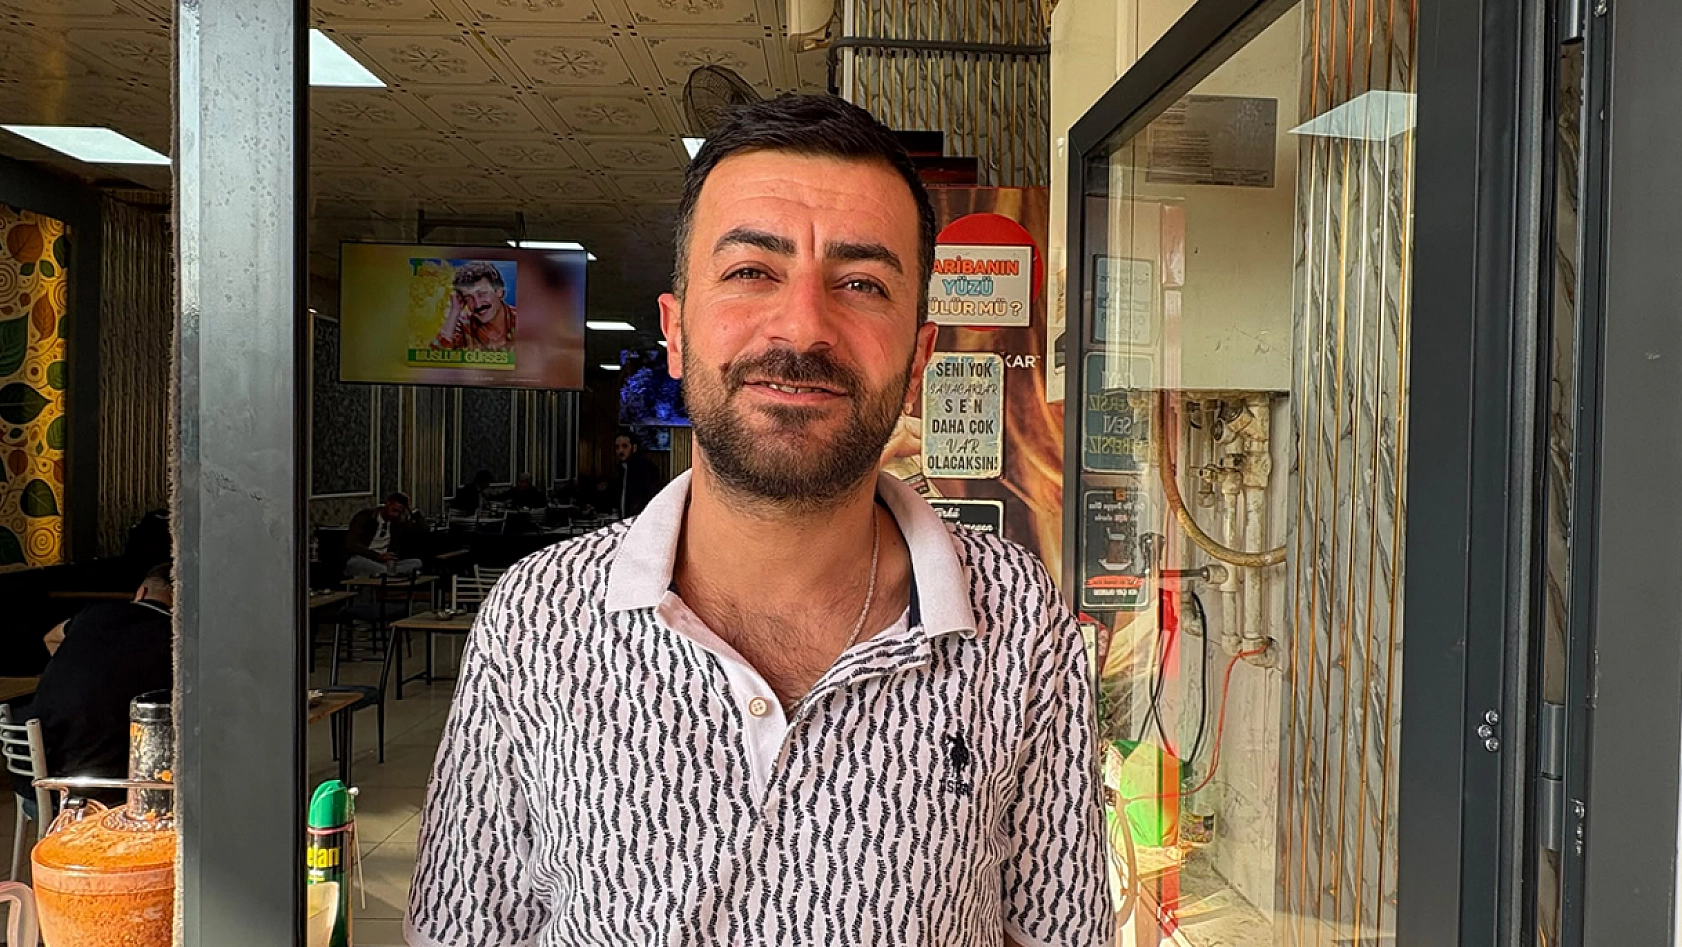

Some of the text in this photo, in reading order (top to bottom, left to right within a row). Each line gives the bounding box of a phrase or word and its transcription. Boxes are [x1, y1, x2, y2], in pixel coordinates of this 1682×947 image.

[932, 255, 1019, 276] ARİBANIN
[942, 276, 993, 296] YÜZÜ
[929, 297, 976, 316] ÜLÜR
[979, 298, 1007, 316] MÜ
[968, 362, 993, 378] YOK
[929, 382, 998, 396] SAYACAKLAR
[932, 419, 994, 436] DAHA ÇOK
[946, 438, 980, 454] VAR
[927, 456, 998, 470] OLACAKSIN!
